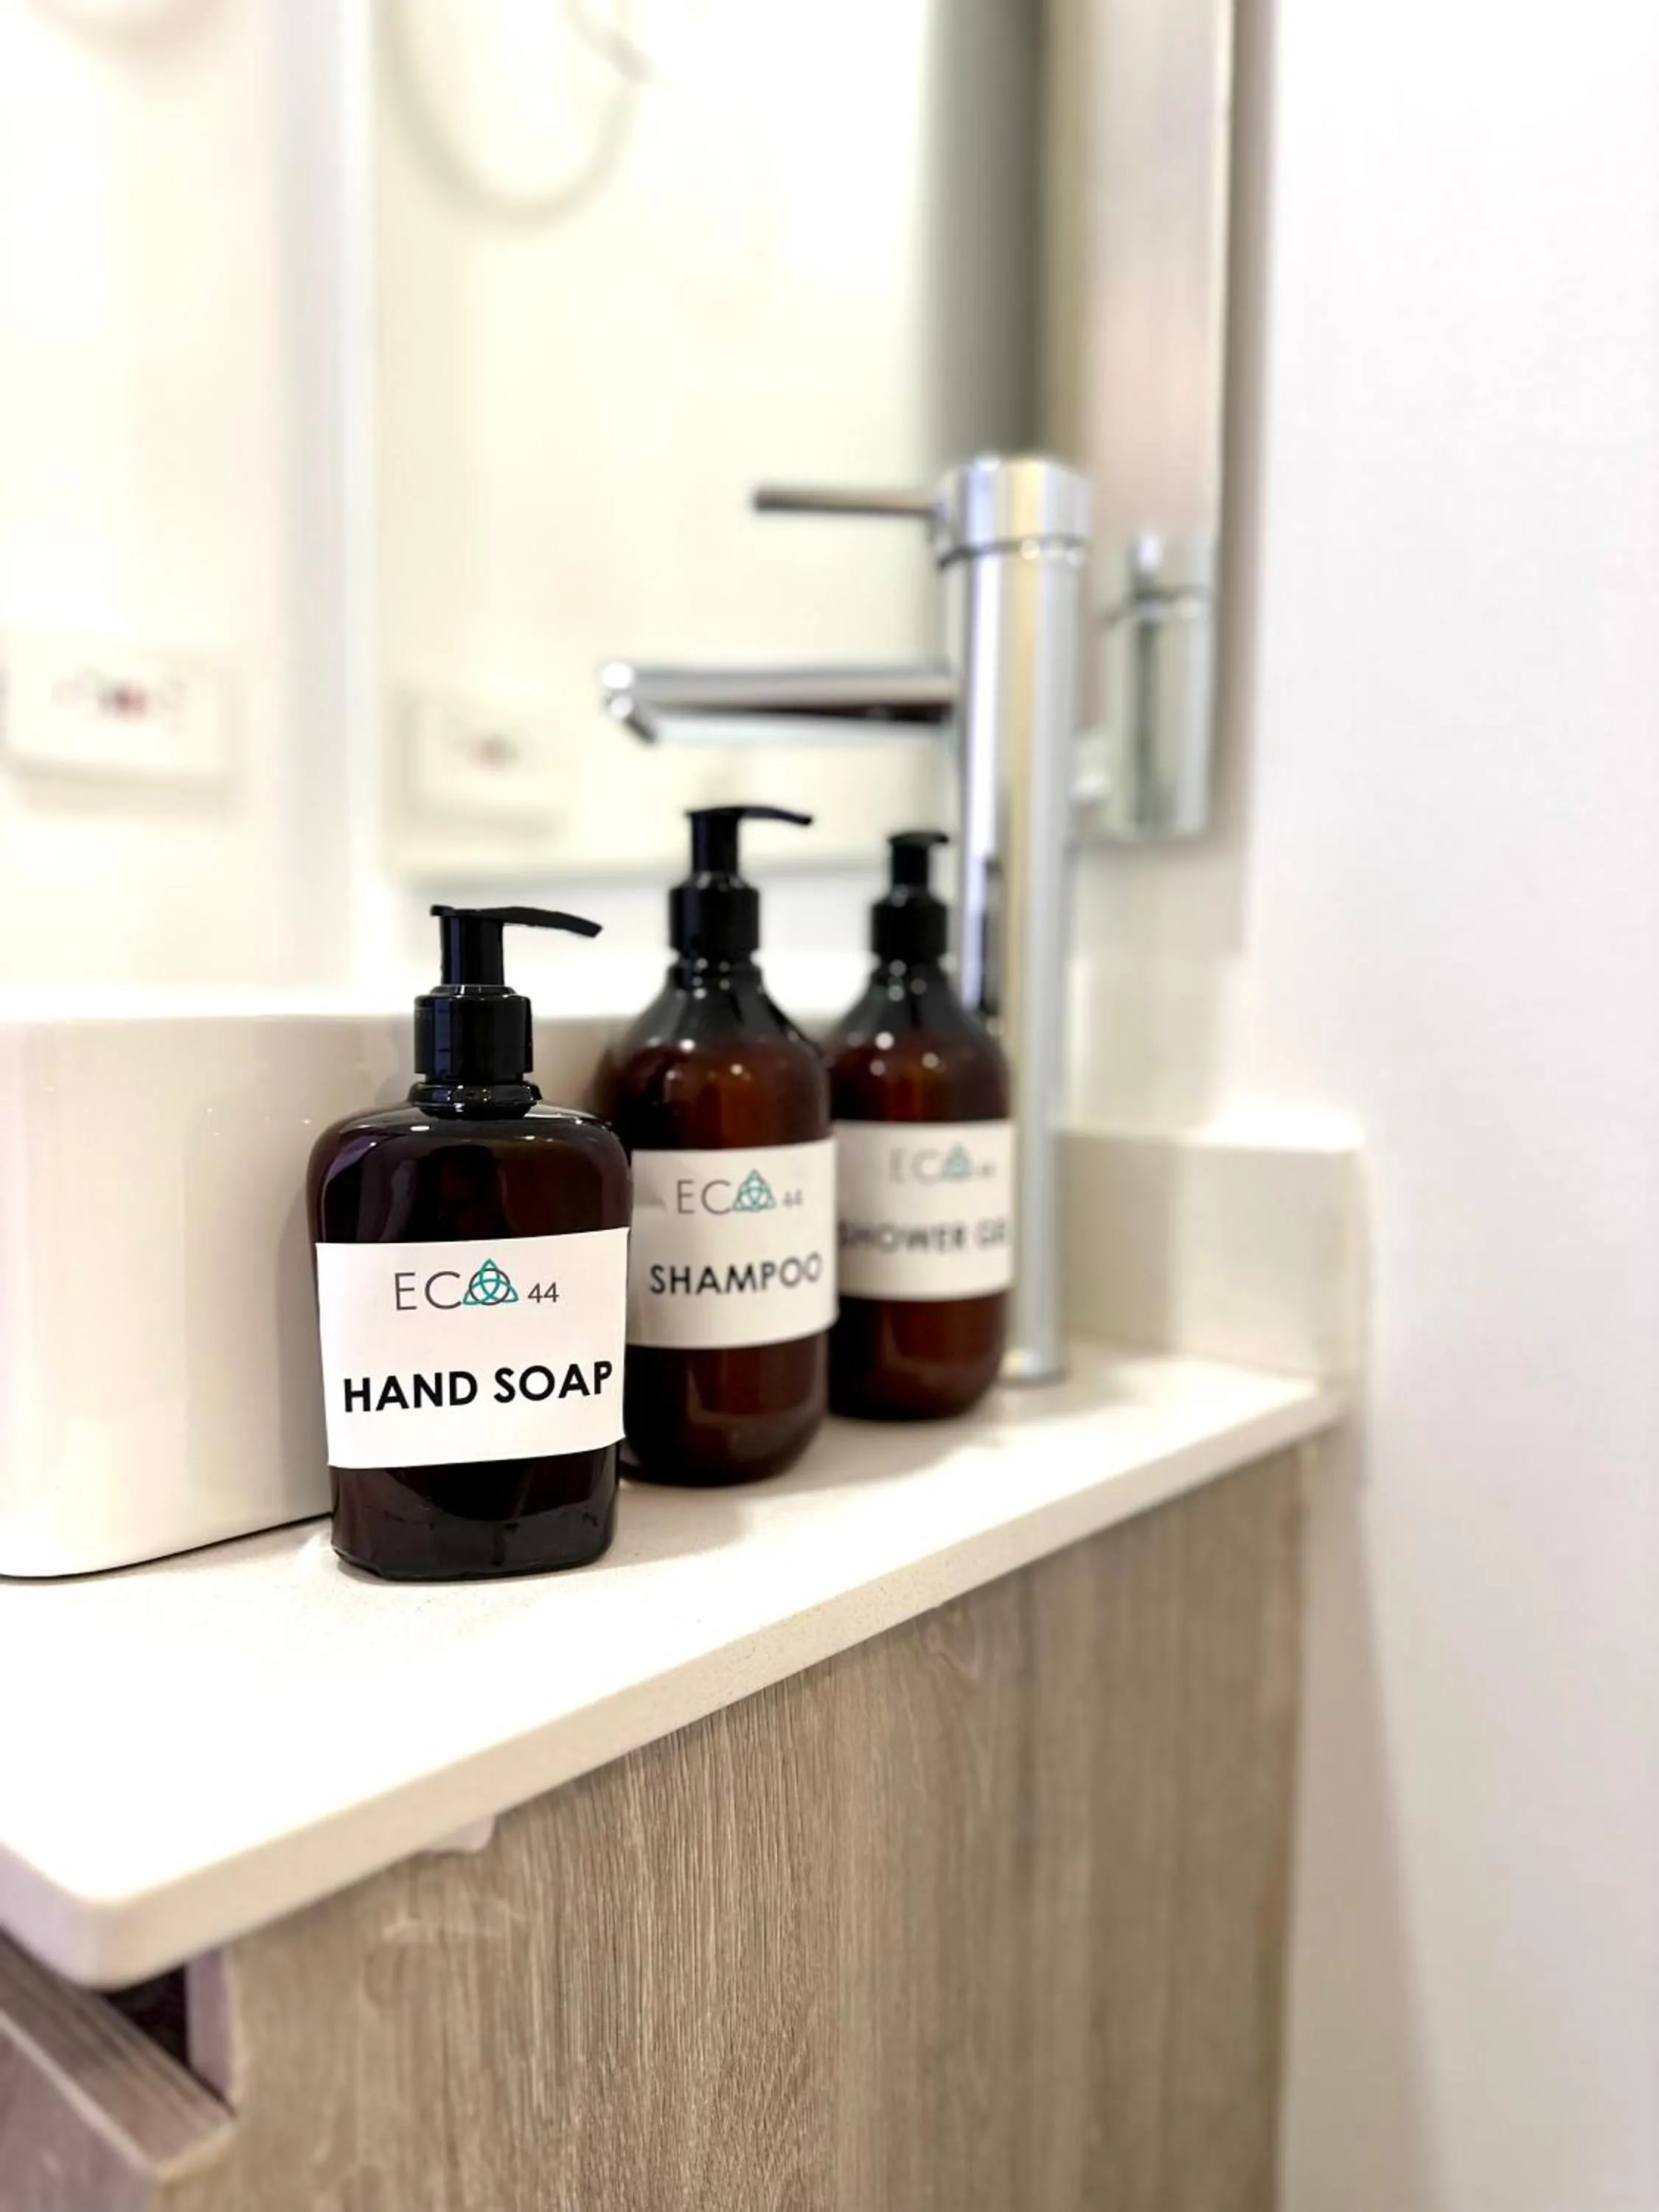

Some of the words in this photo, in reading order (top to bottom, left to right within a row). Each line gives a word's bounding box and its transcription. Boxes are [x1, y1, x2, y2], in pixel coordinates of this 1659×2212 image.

[527, 1281, 560, 1304] 44
[649, 1251, 823, 1295] SHAMPOO
[343, 1371, 478, 1413] HAND
[493, 1360, 613, 1404] SOAP
